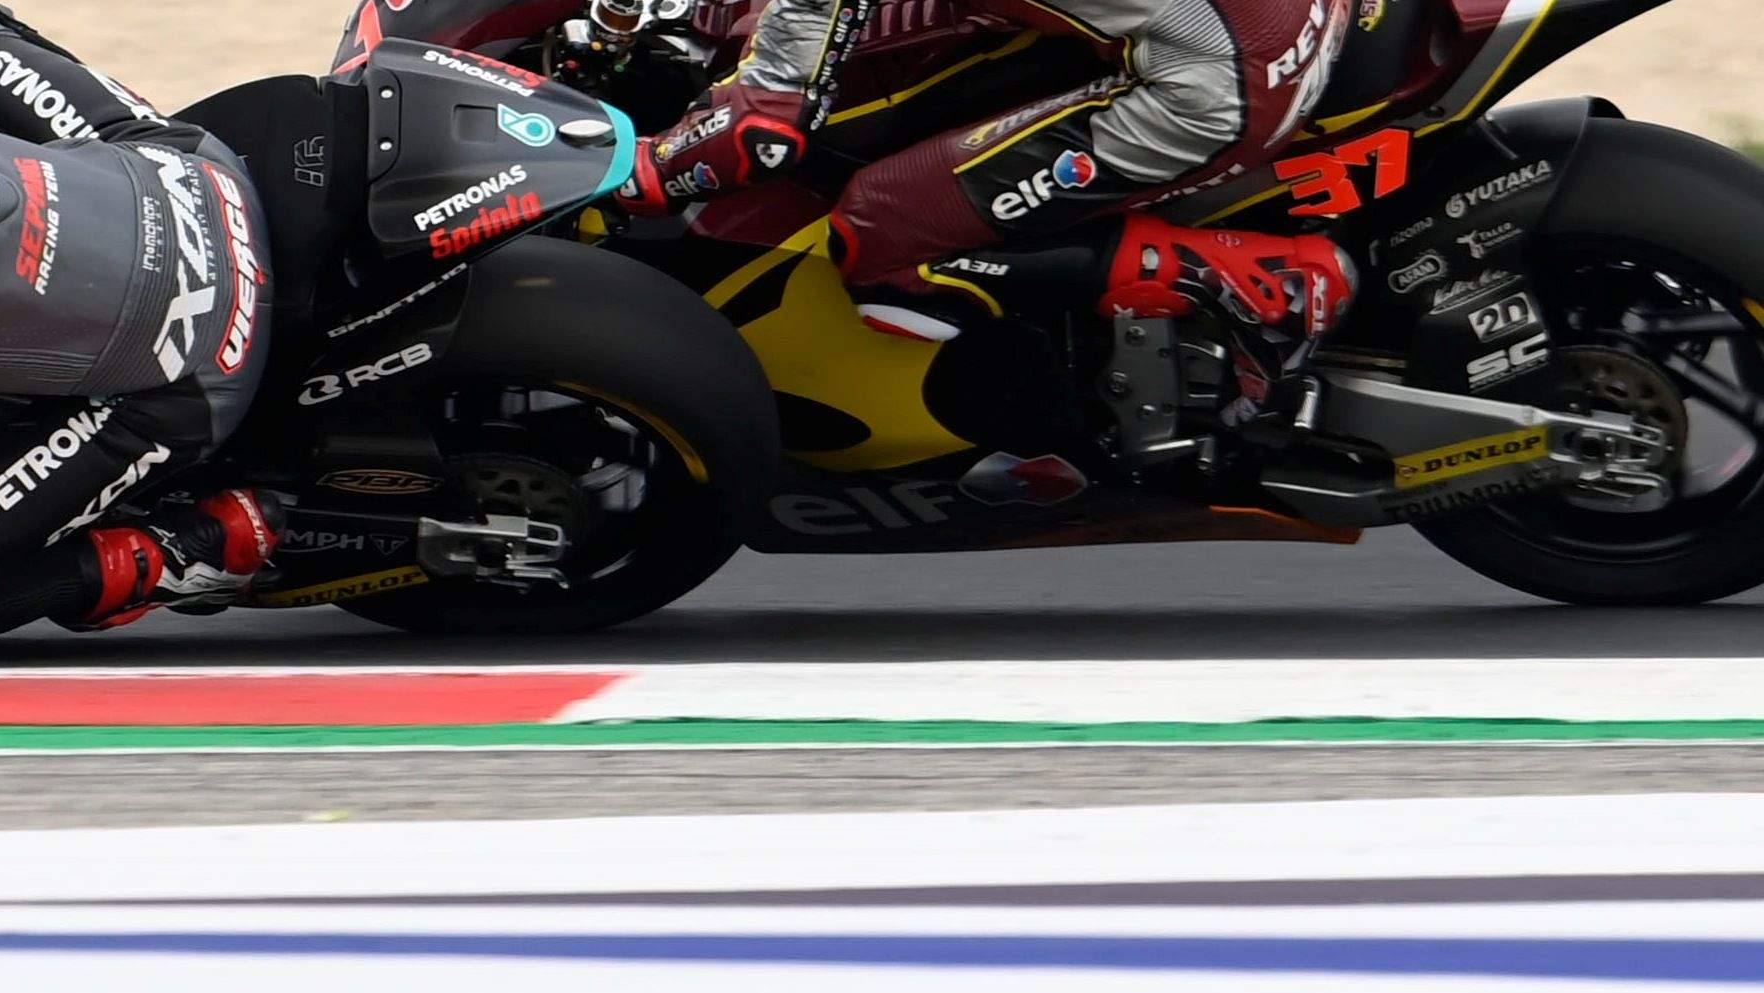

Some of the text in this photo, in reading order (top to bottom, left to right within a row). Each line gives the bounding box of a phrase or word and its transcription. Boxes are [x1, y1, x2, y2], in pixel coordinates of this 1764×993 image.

[422, 49, 536, 98] PETRONAS
[413, 164, 528, 232] PETRONAS
[665, 171, 699, 197] elf
[991, 168, 1056, 221] elf
[1273, 129, 1410, 216] 37
[1465, 160, 1553, 206] YUTAKA
[34, 209, 61, 296] RACING
[209, 166, 258, 370] VIERGE
[345, 342, 433, 388] RCB
[1467, 331, 1549, 384] SC
[1423, 434, 1542, 474] DUNLOP
[767, 478, 955, 537] elf
